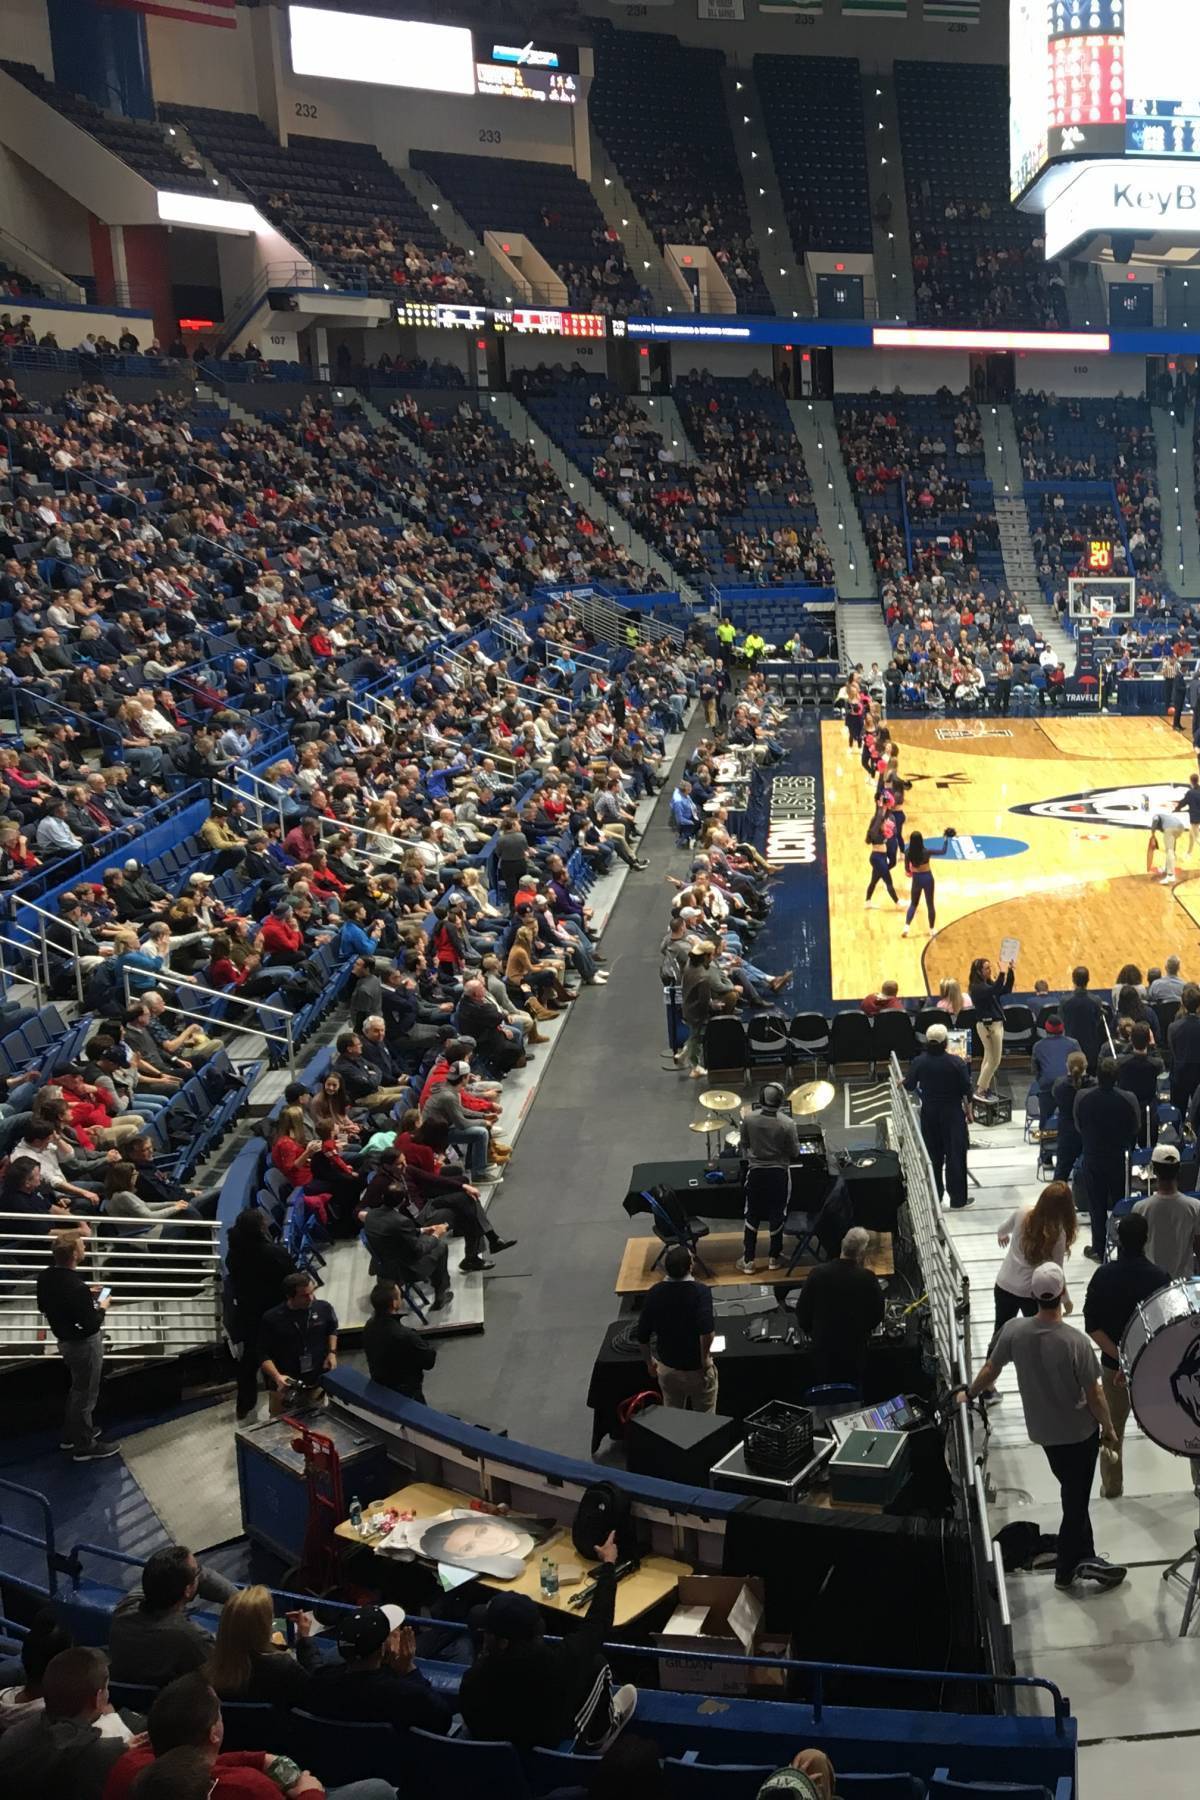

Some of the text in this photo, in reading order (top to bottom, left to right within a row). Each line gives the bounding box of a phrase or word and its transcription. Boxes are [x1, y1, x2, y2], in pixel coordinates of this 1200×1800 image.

[295, 103, 318, 119] 232
[479, 128, 502, 144] 233
[270, 335, 286, 345] 107
[1066, 693, 1099, 702] TRAVELE
[766, 820, 817, 864] UCONN
